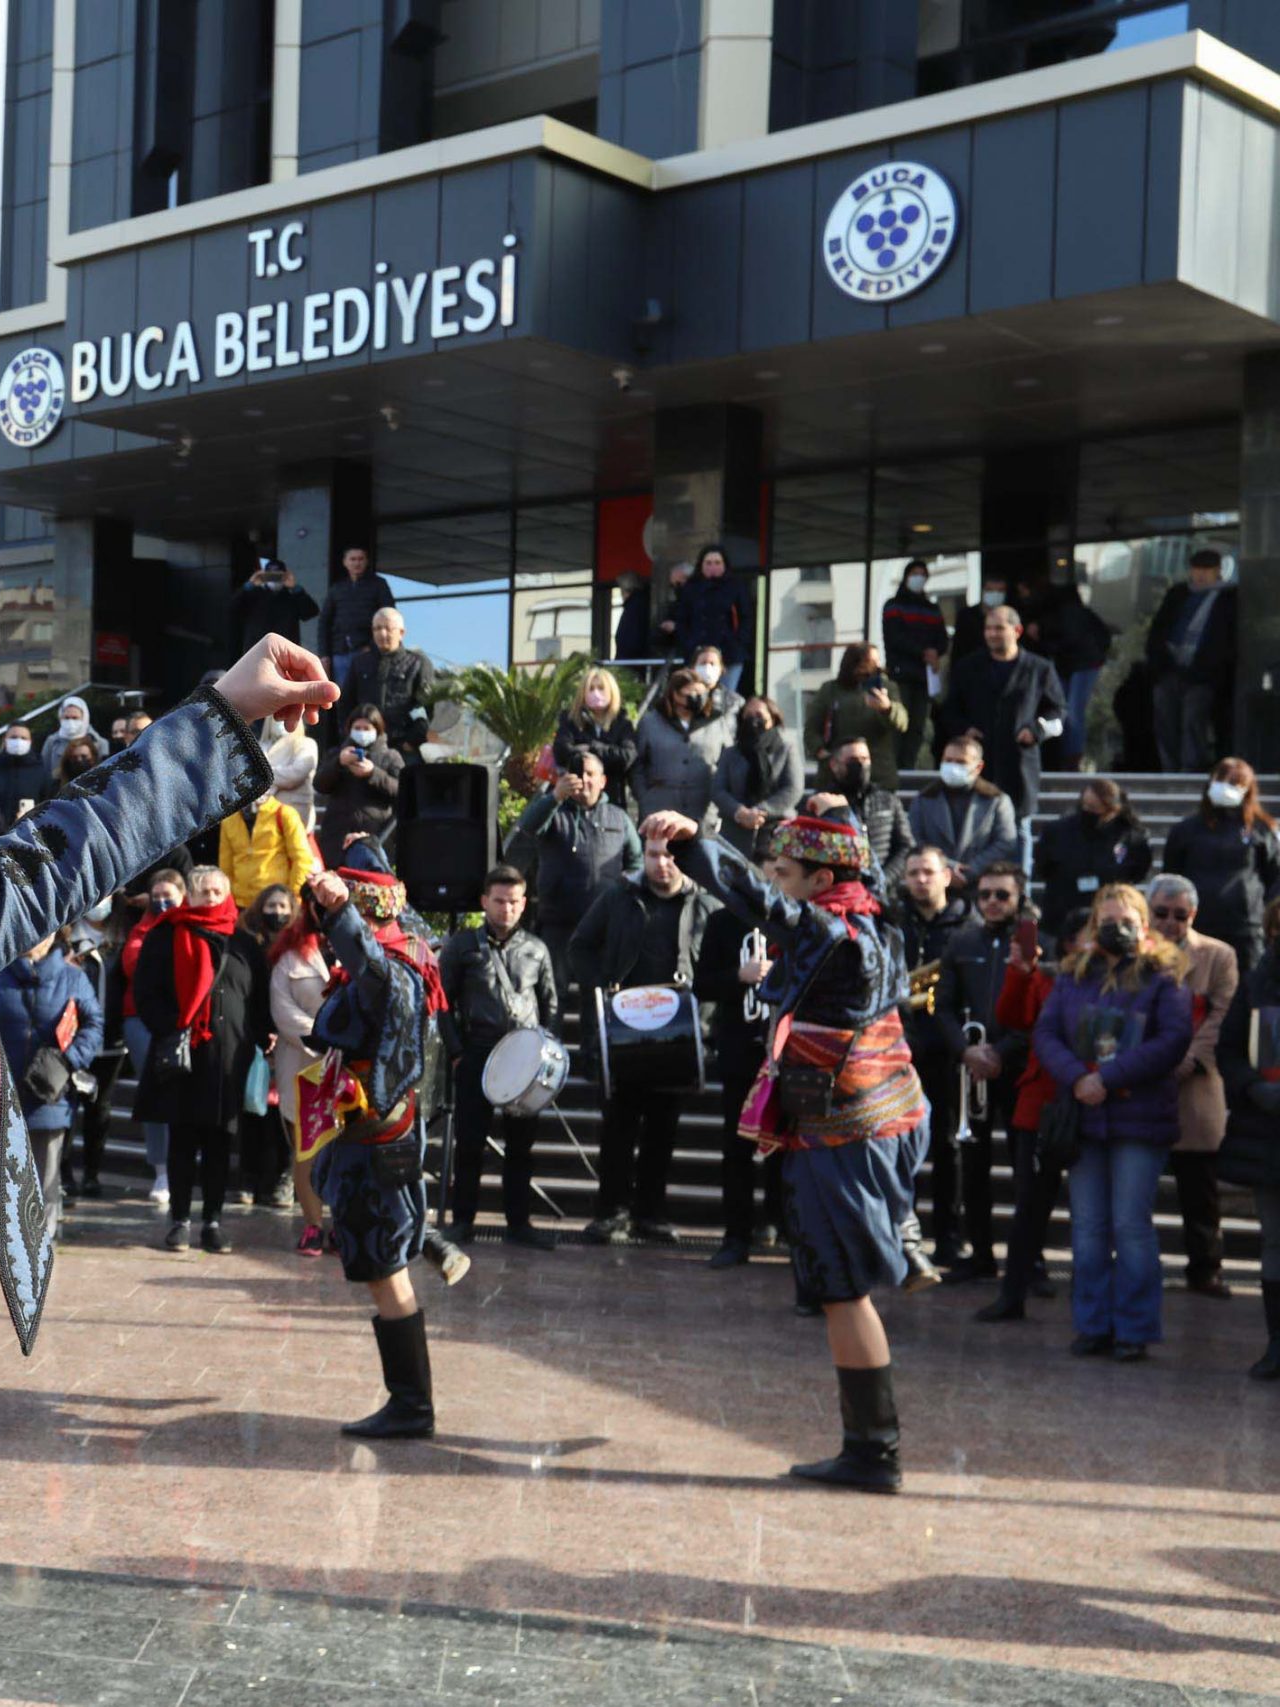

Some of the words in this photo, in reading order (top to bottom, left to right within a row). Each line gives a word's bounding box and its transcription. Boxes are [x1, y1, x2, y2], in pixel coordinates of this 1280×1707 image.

[852, 169, 926, 201] BUCA
[248, 222, 304, 277] T.C
[71, 321, 201, 403] BUCA
[215, 234, 516, 378] BELEDİYESİ
